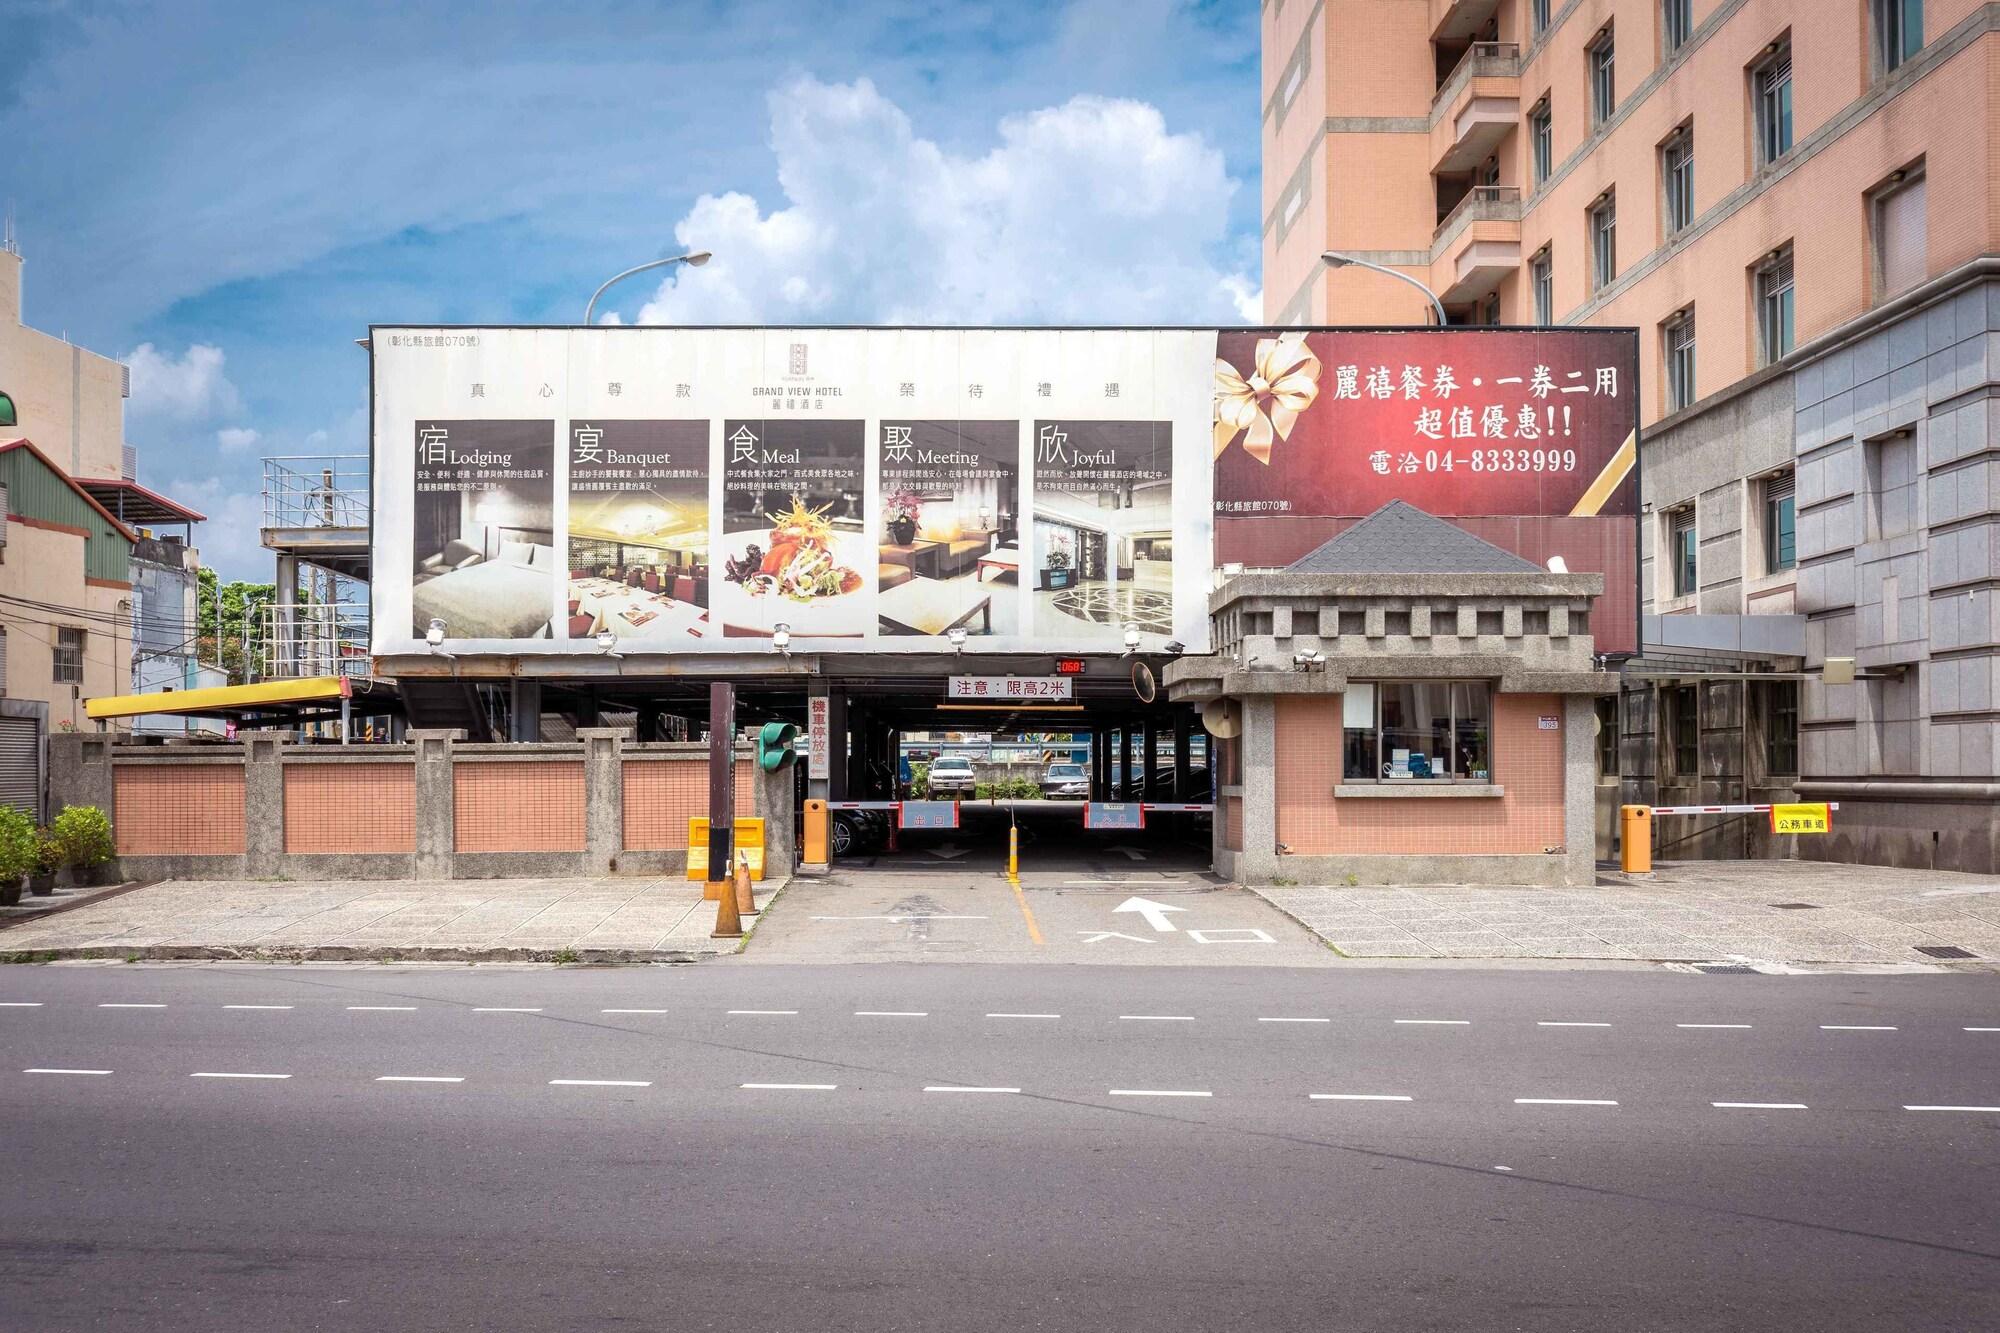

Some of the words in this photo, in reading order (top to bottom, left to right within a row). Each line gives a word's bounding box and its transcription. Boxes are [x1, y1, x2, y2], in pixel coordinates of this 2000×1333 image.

[752, 387, 783, 396] GRAND
[788, 387, 811, 396] VIEW
[815, 387, 843, 396] HOTEL
[418, 424, 449, 465] 宿
[573, 423, 604, 464] 宴
[728, 424, 760, 464] 食
[883, 426, 914, 464] 聚
[1037, 425, 1068, 464] 欣
[450, 448, 512, 468] Lodging
[607, 449, 671, 468] Banquet
[761, 448, 800, 464] Meal
[917, 449, 979, 468] Meeting
[1071, 449, 1115, 468] Joyful
[1062, 662, 1080, 672] 068
[1778, 818, 1826, 830] 公務車道
